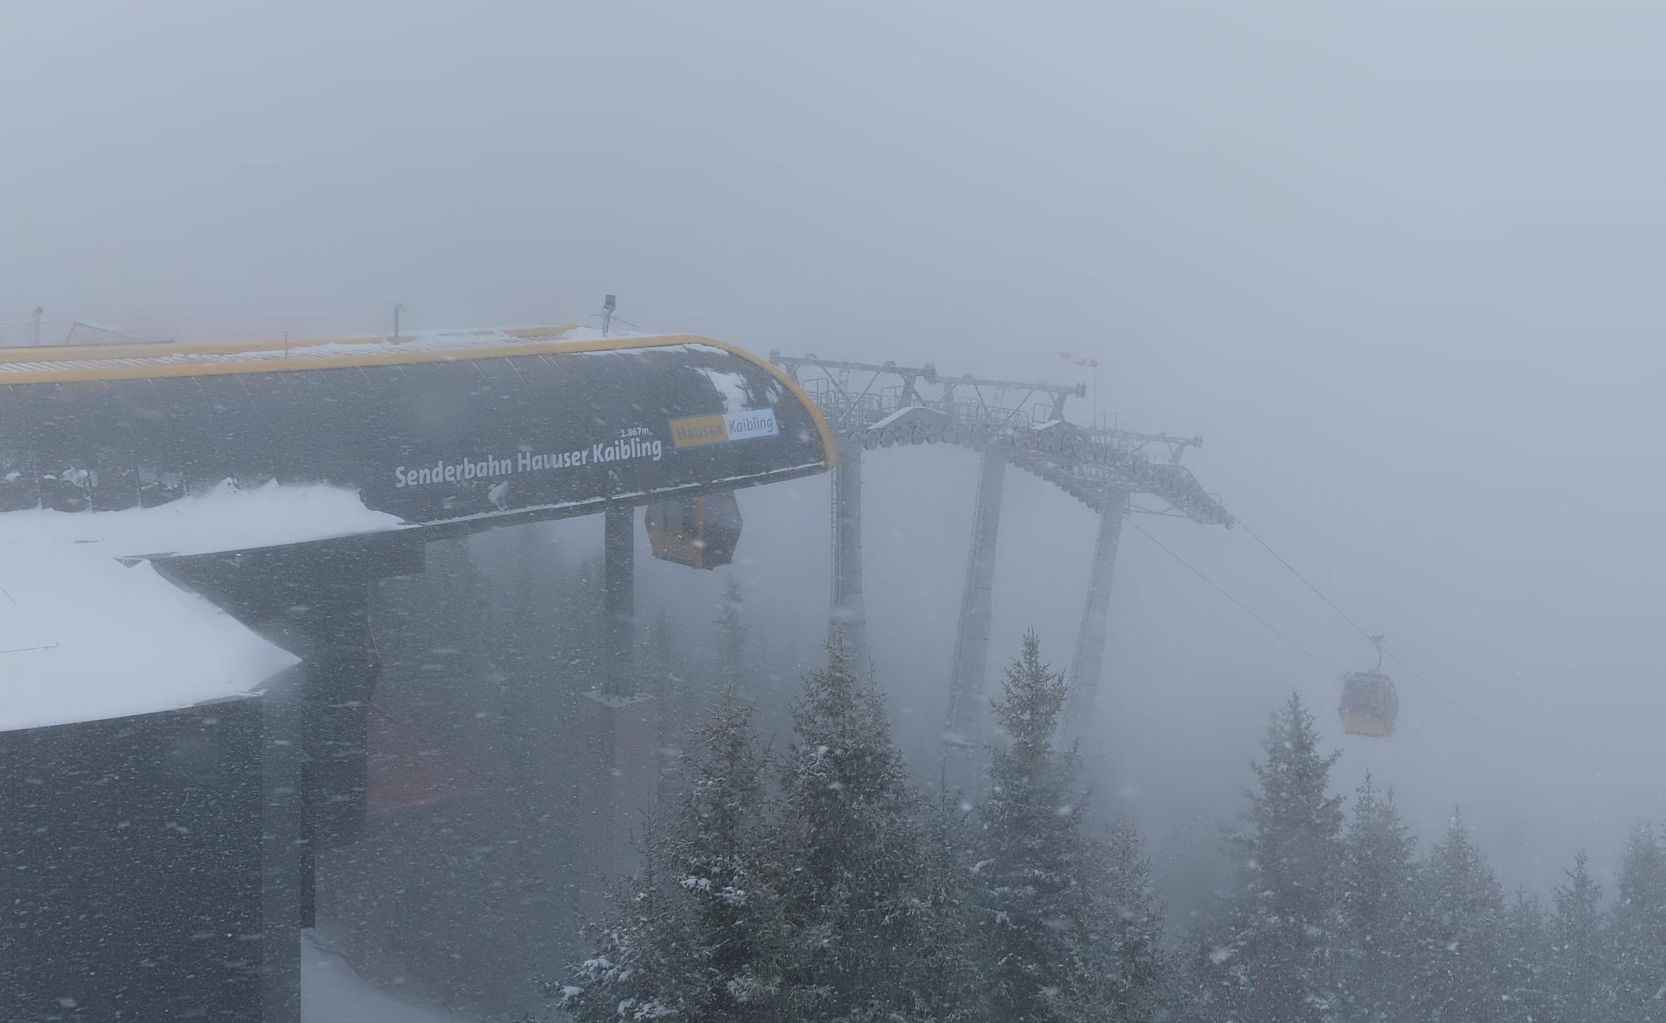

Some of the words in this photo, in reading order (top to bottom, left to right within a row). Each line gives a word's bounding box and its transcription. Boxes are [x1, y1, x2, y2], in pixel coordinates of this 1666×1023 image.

[729, 415, 774, 434] Kaibling
[395, 454, 512, 488] Senderbahn
[593, 437, 662, 463] Kaibling
